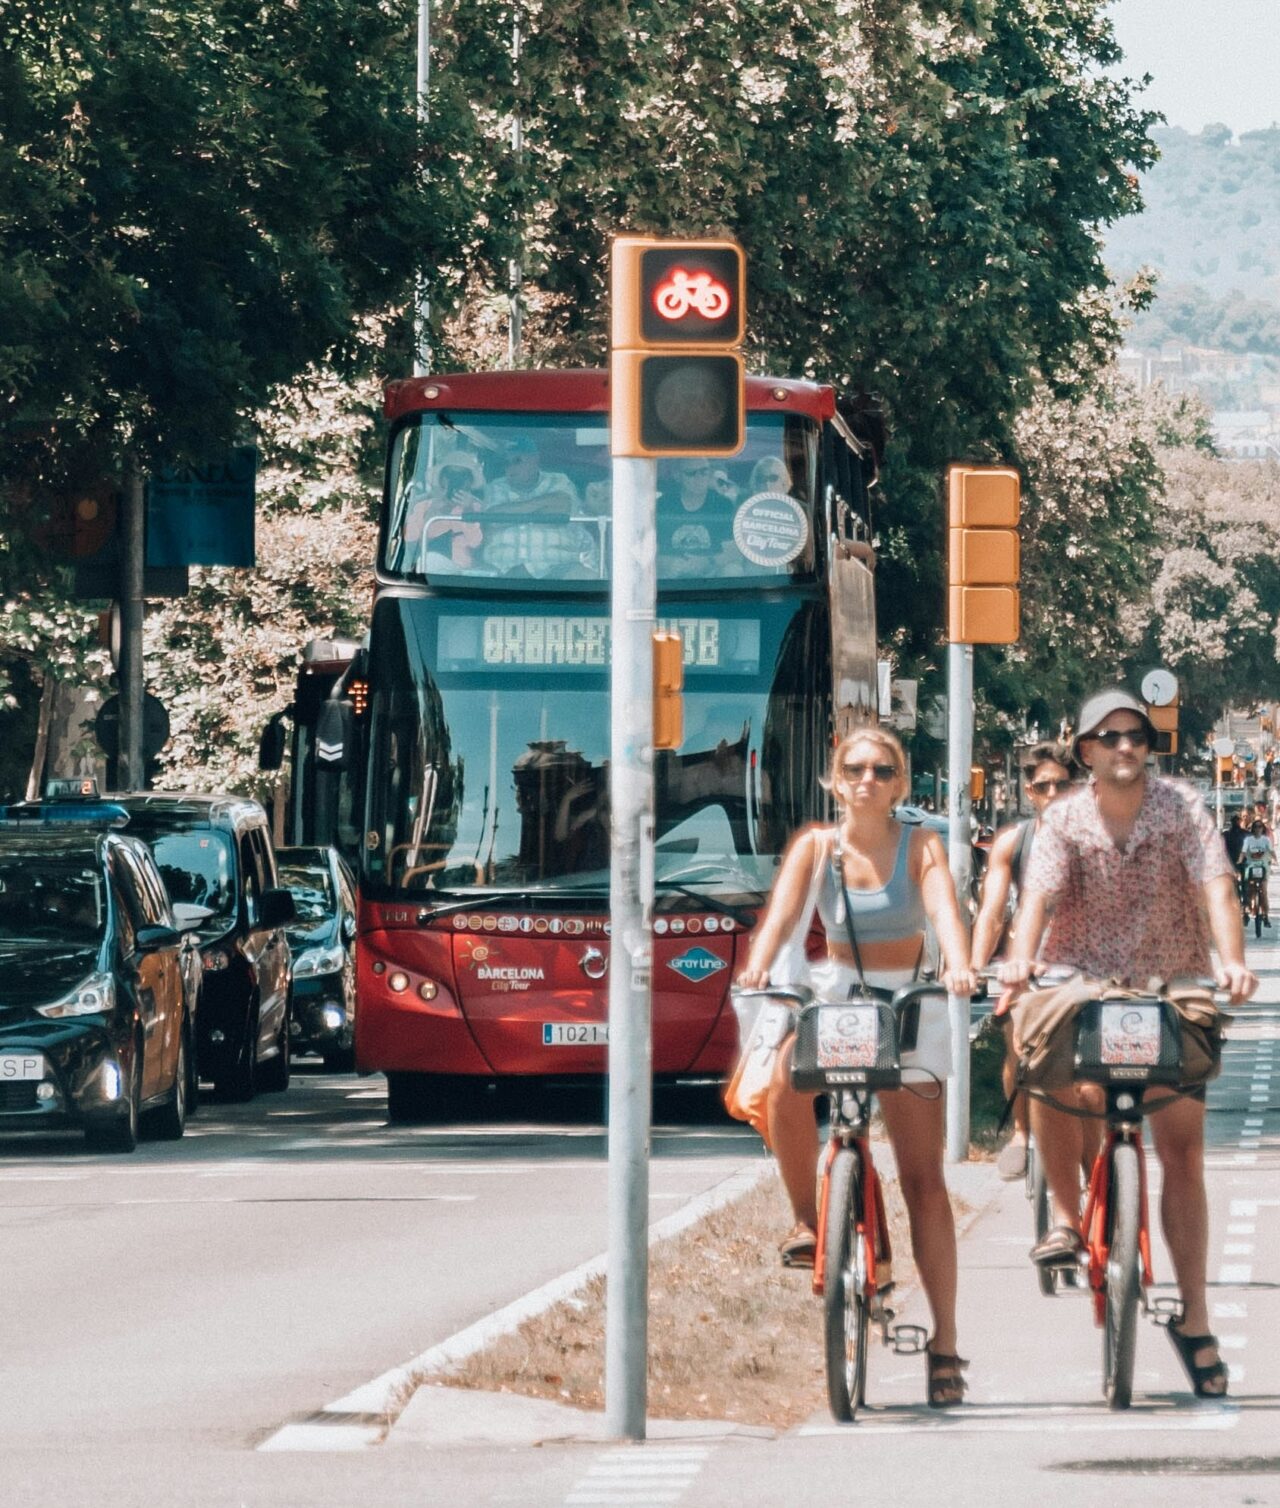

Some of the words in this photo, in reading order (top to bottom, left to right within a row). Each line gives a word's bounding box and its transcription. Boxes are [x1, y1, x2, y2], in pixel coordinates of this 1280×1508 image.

[752, 508, 795, 522] OFFICIAL
[742, 520, 800, 537] BARCELONA
[477, 967, 545, 980] BARCELONA
[492, 981, 510, 992] City
[509, 981, 531, 991] Tour
[558, 1026, 598, 1042] 1021
[3, 1059, 37, 1077] SP
